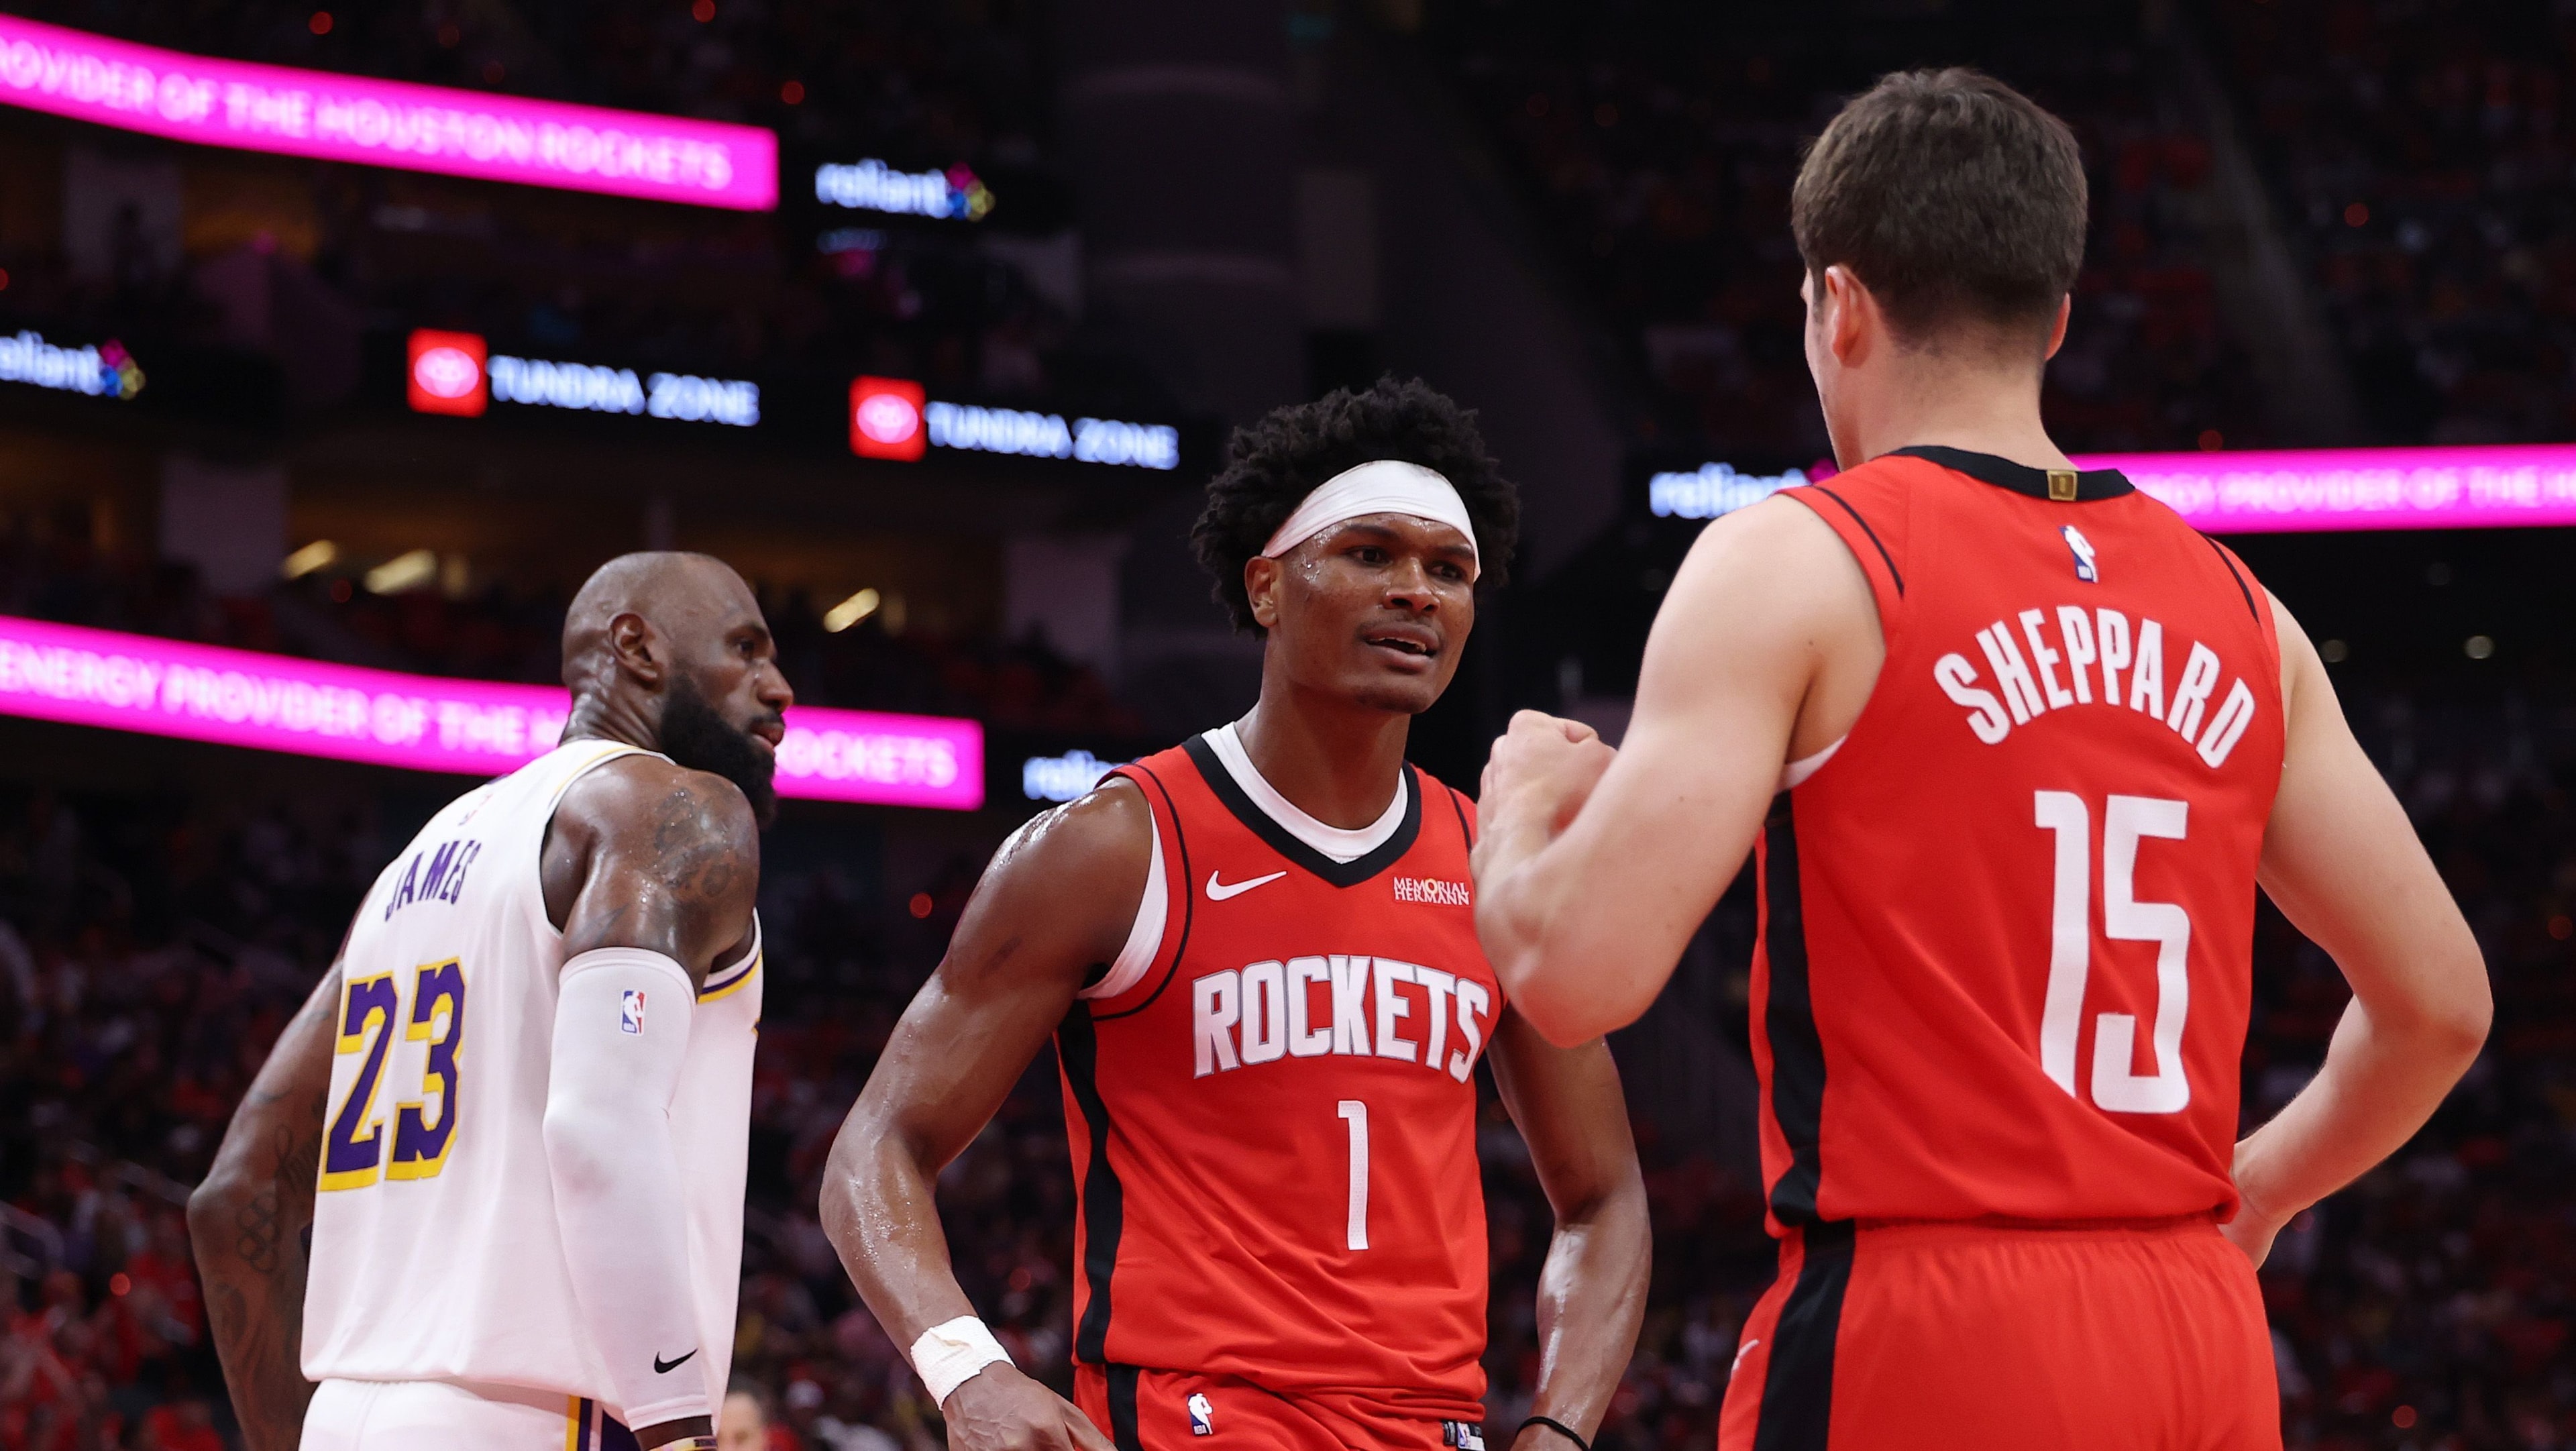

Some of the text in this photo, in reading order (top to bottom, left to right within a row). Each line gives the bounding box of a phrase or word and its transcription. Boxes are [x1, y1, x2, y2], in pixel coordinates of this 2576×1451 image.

[156, 72, 219, 124] OF
[222, 82, 312, 138] THE
[313, 93, 535, 166] HOUSTON
[535, 121, 733, 192] ROCKETS
[486, 355, 761, 427] TUNDRA ZONE
[924, 401, 1180, 470] TUNDRA ZONE
[162, 661, 368, 740] PROVIDER
[368, 692, 430, 748] OF
[435, 700, 527, 755] THE
[773, 727, 959, 788] OCKETS
[1933, 604, 2255, 769] SHEPPARD
[384, 840, 482, 922] JAMES
[1393, 876, 1470, 895] MEMORIAL
[1394, 887, 1470, 906] HERMANN
[2033, 789, 2191, 1114] 15
[317, 955, 466, 1193] 23
[1191, 954, 1491, 1085] ROCKETS
[1338, 1099, 1370, 1251] 1
